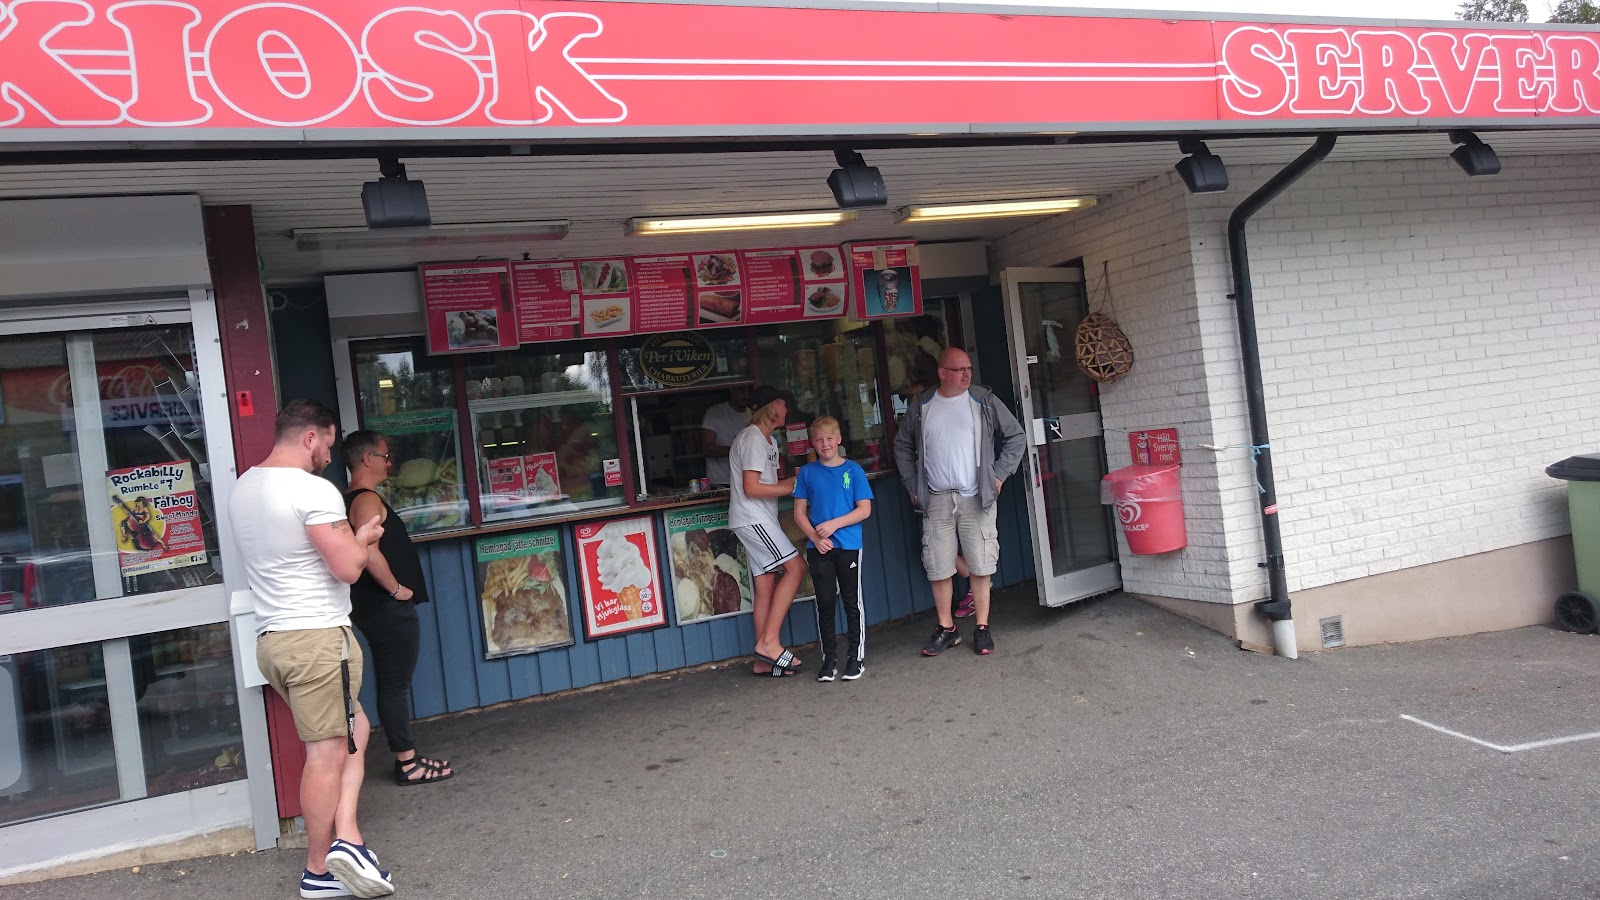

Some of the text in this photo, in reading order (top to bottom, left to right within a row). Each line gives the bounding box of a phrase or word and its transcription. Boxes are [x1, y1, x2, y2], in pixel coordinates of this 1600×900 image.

[0, 0, 628, 126] KIOSK
[644, 349, 710, 363] Per i Viken
[648, 364, 708, 382] CHARKUTERIER
[1157, 432, 1170, 442] Håll
[1153, 443, 1176, 452] Sverige
[110, 466, 184, 487] Rockabilly
[120, 482, 159, 495] Rumble
[153, 495, 193, 509] Fatboy
[479, 534, 556, 555] Hemlagad jätte schnitzel
[594, 598, 618, 612] Vi har
[596, 604, 632, 621] Mjukglass
